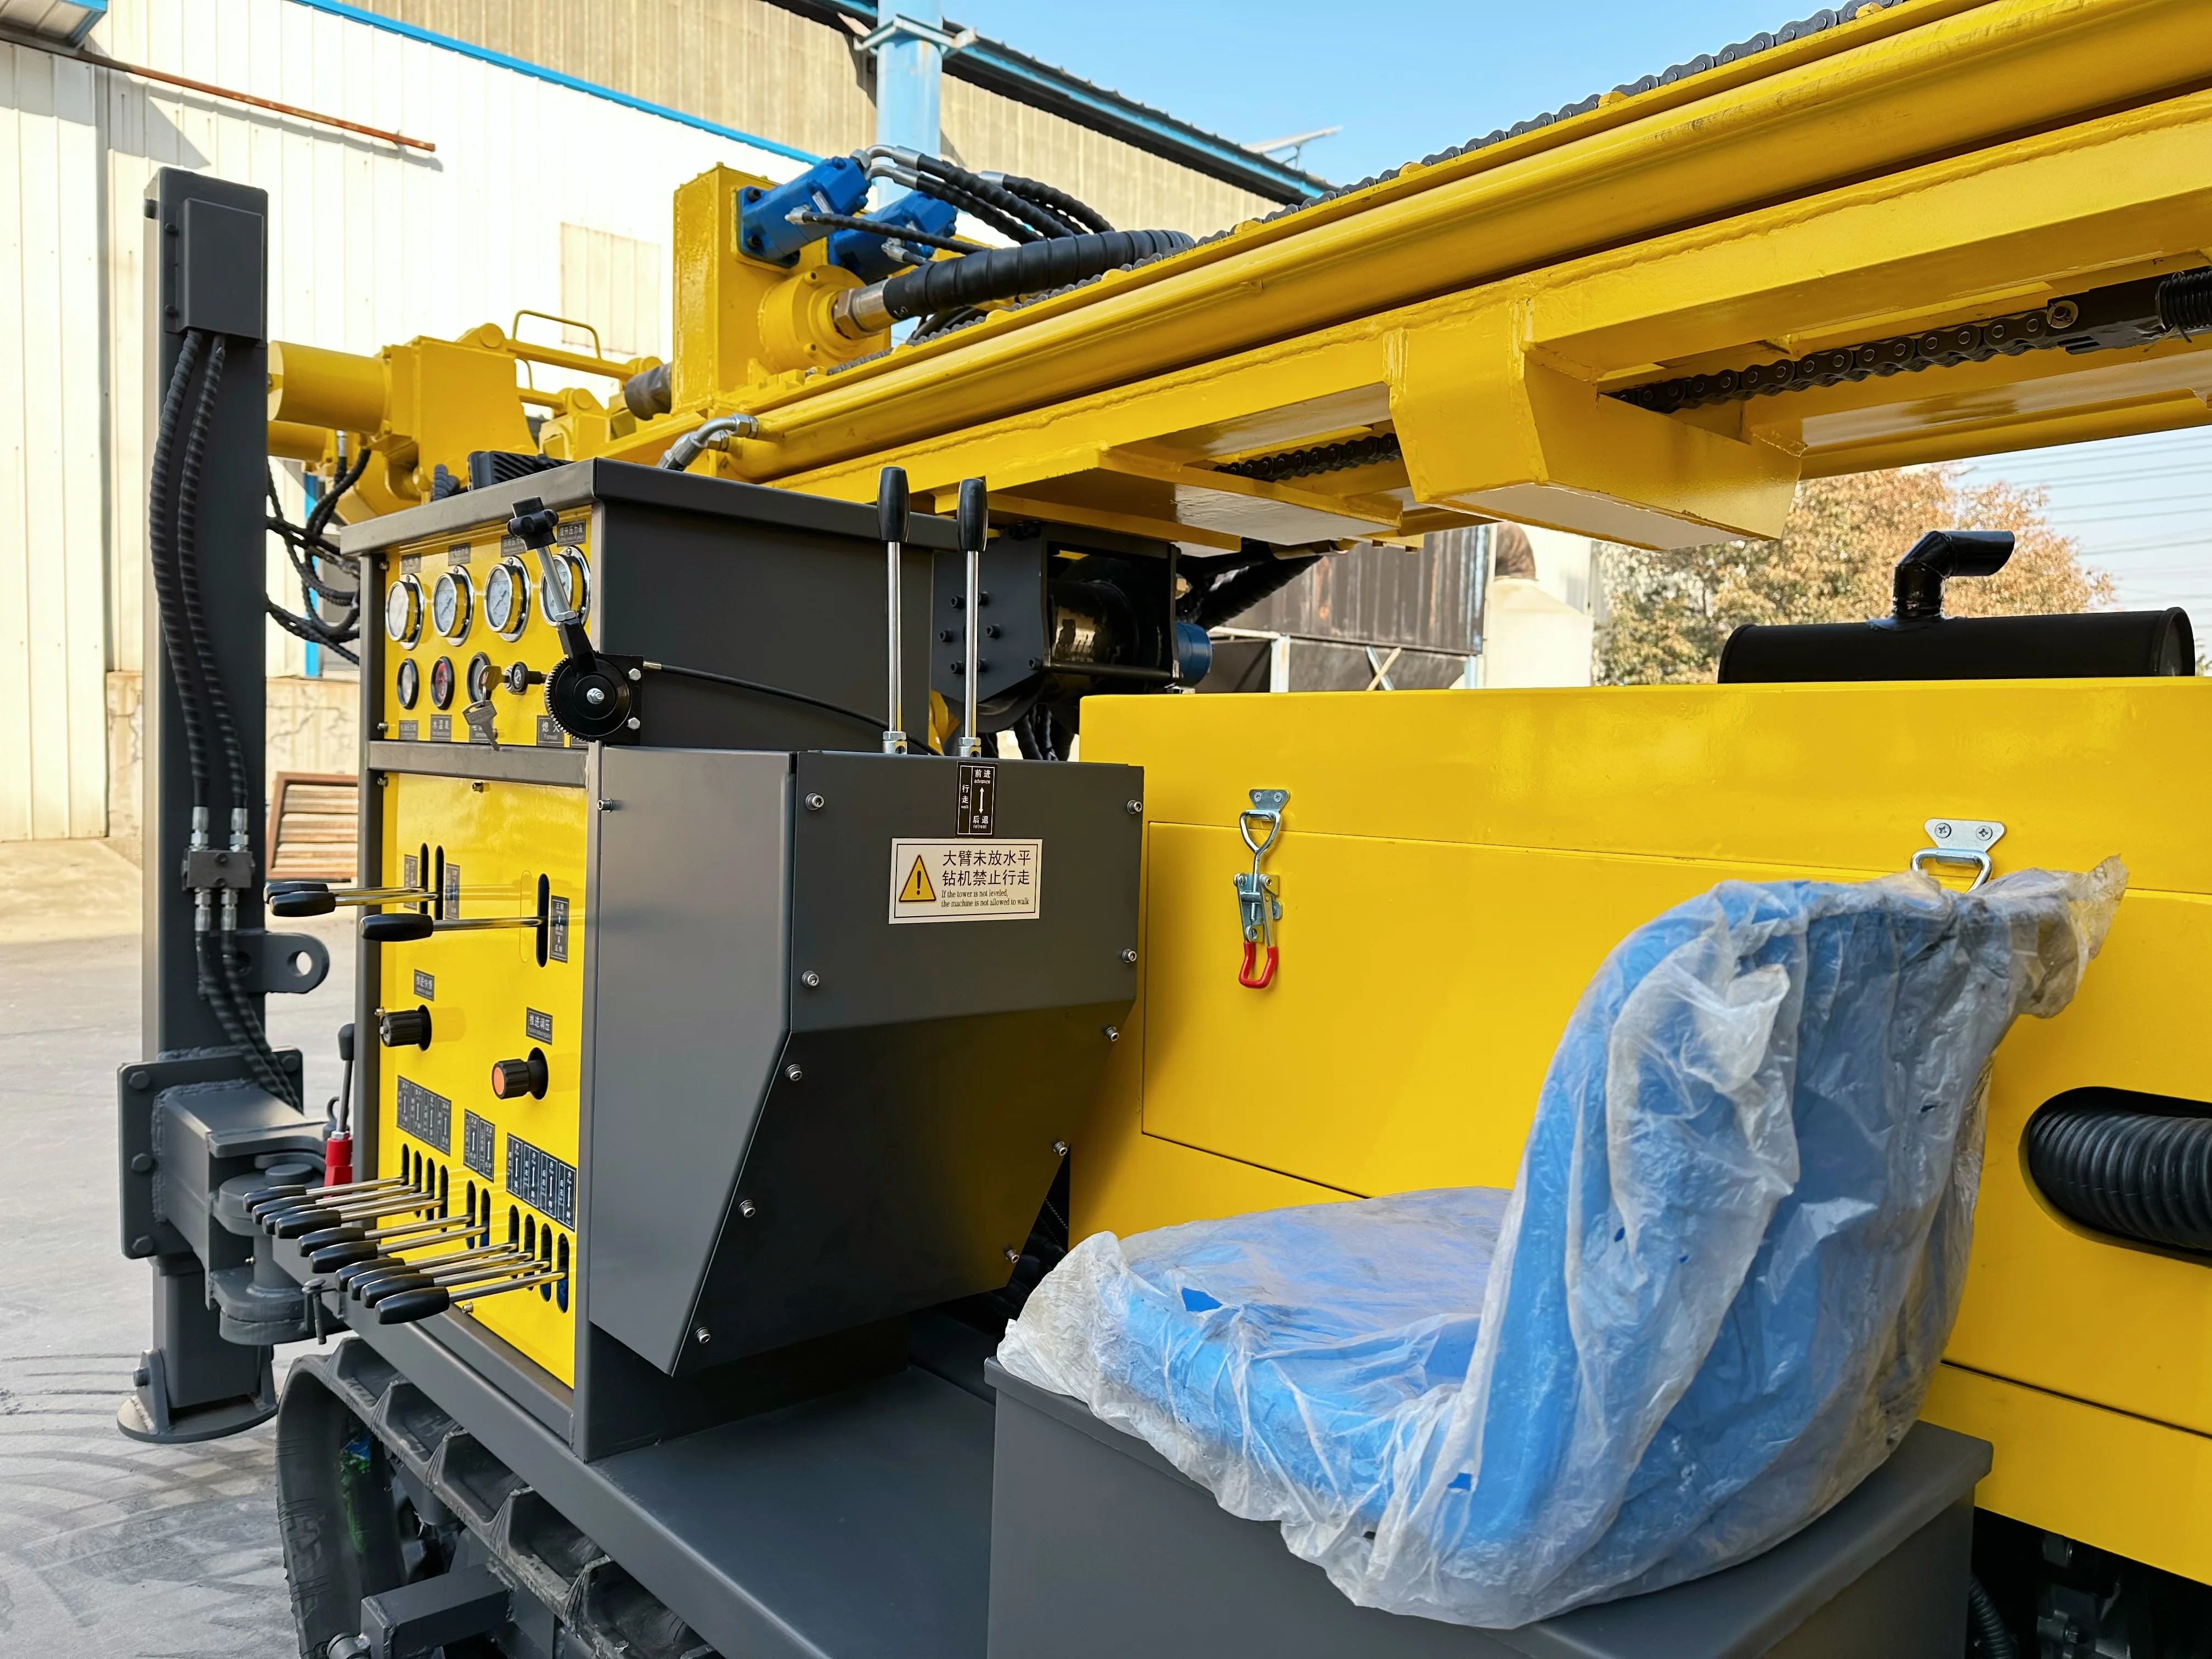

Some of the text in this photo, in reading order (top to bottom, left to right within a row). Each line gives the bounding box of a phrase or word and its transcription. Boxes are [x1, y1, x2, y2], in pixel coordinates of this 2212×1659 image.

[974, 769, 991, 778] 前进
[962, 784, 970, 804] 行走
[972, 815, 989, 824] 后退
[942, 849, 1031, 867] 大臂未放水平
[941, 869, 1030, 887] 钻机禁止行走
[941, 890, 946, 898] If
[947, 890, 956, 898] the
[989, 889, 1008, 898] leveled,
[941, 899, 950, 907] the
[951, 899, 974, 907] machine
